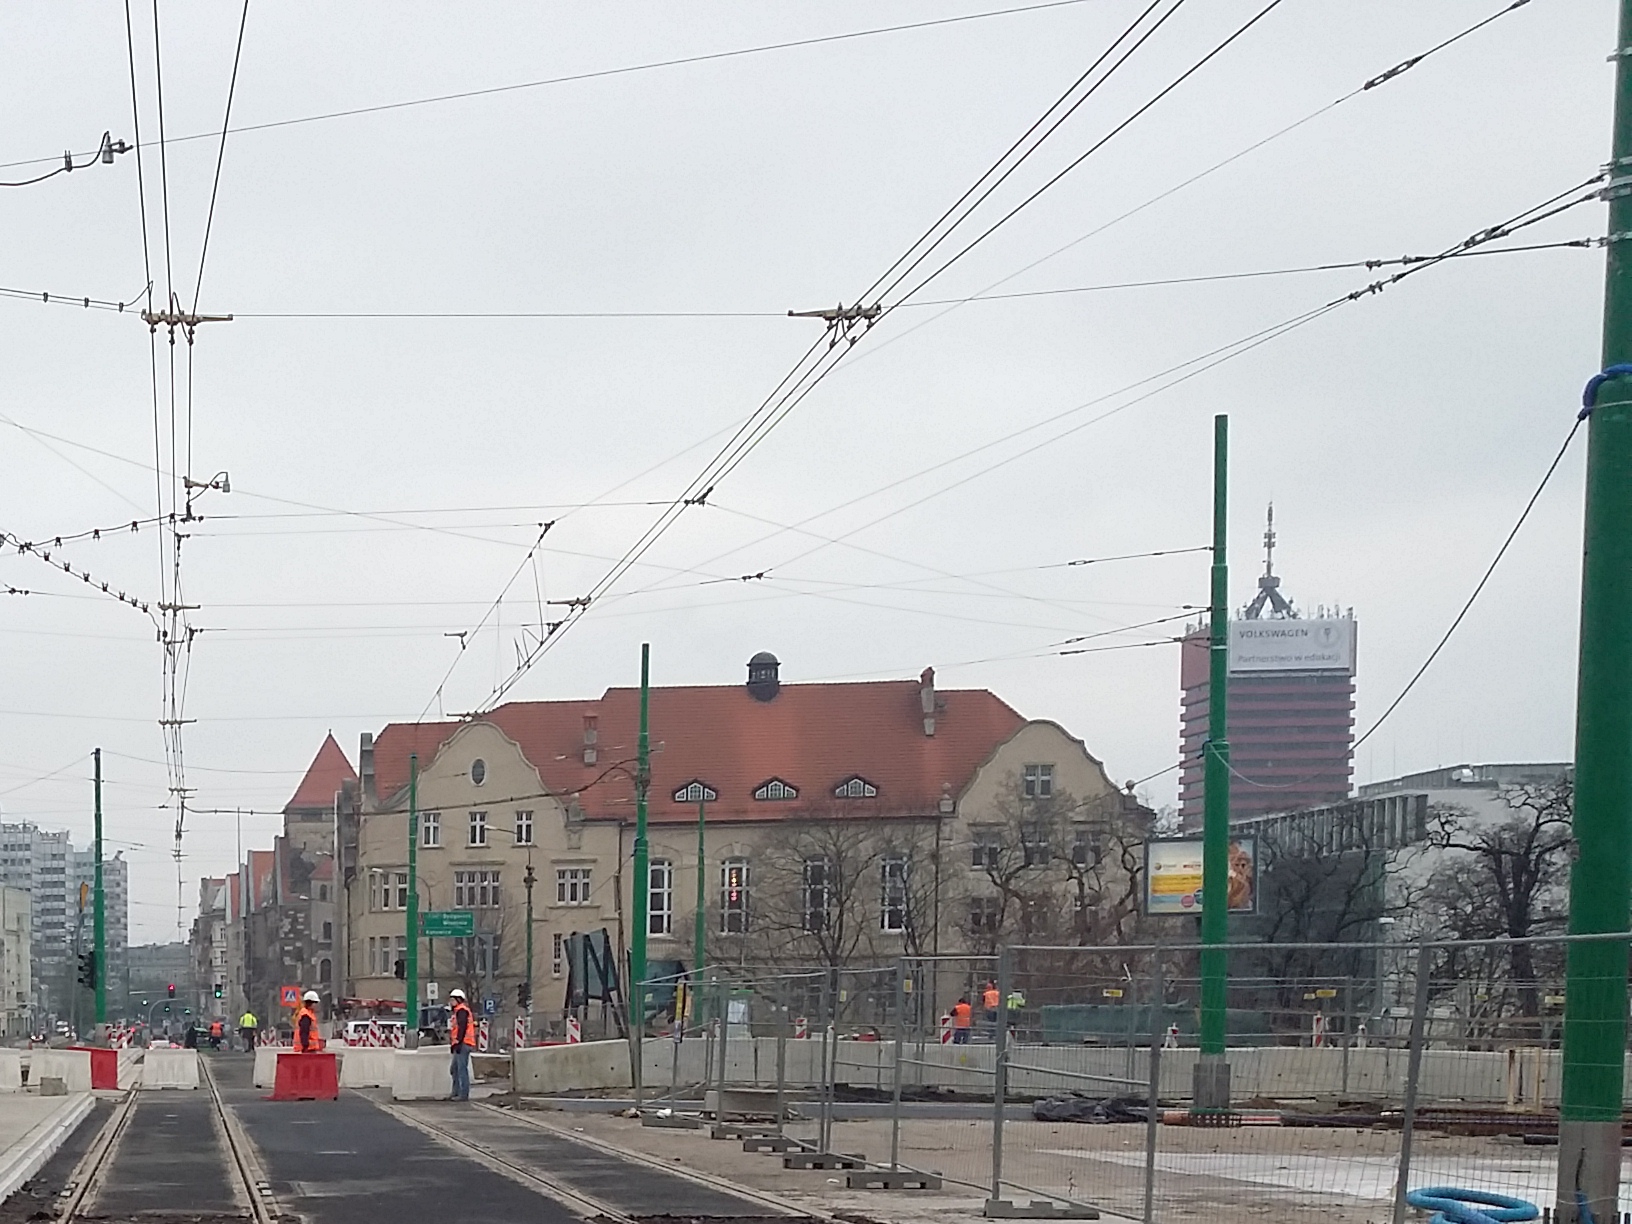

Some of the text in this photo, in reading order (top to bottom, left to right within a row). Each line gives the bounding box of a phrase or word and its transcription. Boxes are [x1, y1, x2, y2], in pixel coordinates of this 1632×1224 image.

[1239, 629, 1309, 639] VOLKSWAGEN
[1238, 655, 1293, 663] Partnerstwo
[1304, 654, 1341, 664] edukacji
